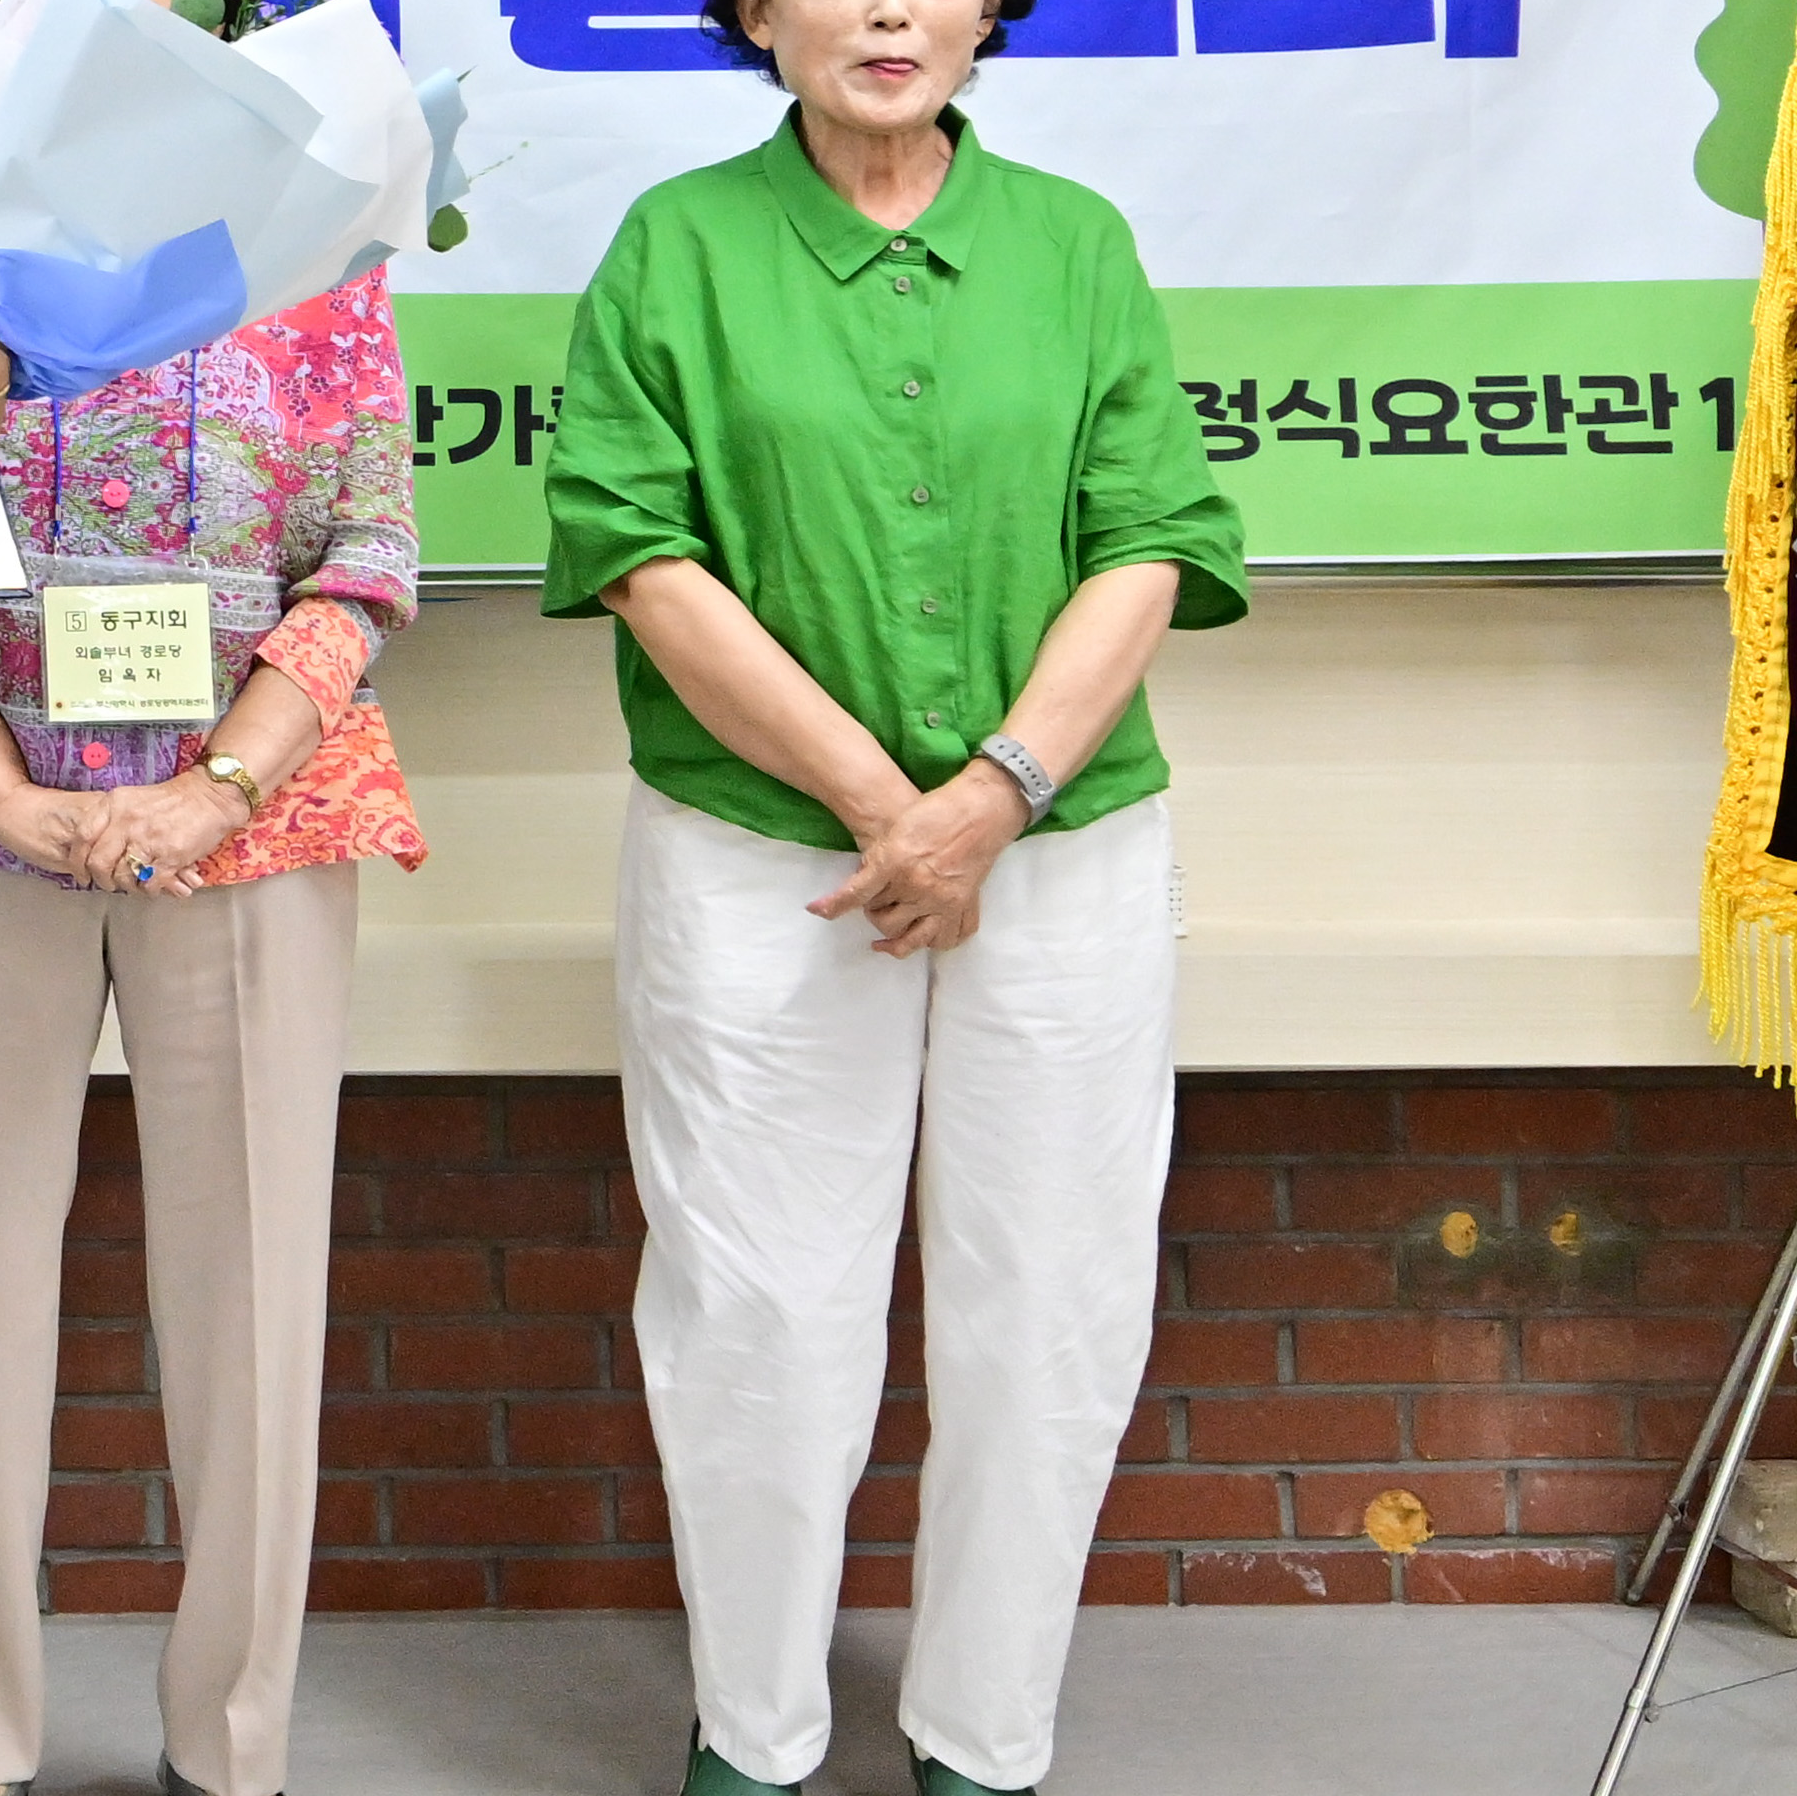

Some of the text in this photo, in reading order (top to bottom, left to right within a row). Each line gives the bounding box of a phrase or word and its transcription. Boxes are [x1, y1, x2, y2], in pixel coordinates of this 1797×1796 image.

[71, 609, 188, 632] 5 동구지회
[140, 644, 183, 659] 경로당
